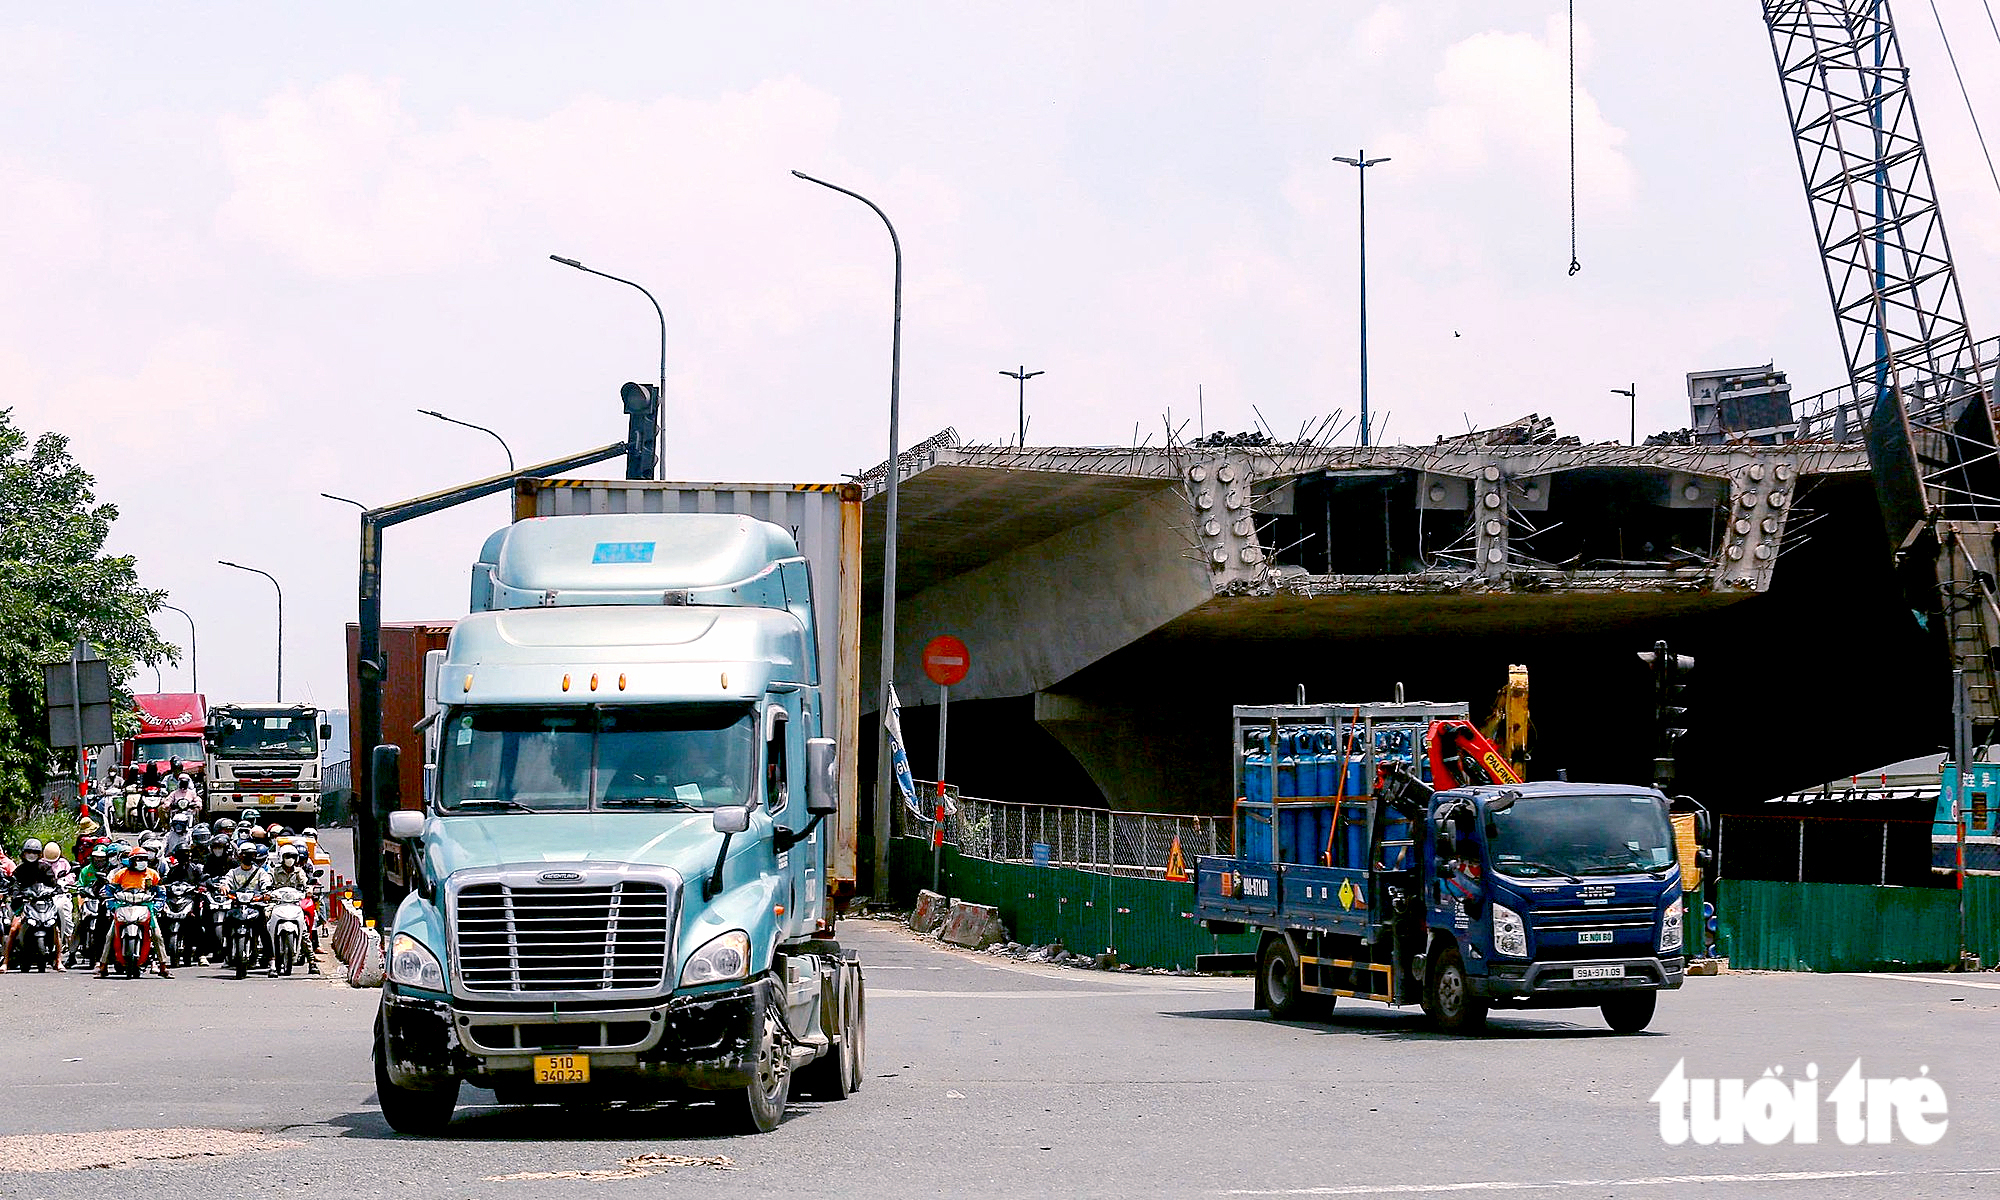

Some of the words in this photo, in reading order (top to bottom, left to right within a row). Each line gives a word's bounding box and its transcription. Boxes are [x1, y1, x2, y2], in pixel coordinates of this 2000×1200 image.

[1580, 933, 1589, 942] XE
[1577, 967, 1621, 978] 99A-971.09
[550, 1057, 574, 1069] 51D
[540, 1069, 584, 1082] 340.23
